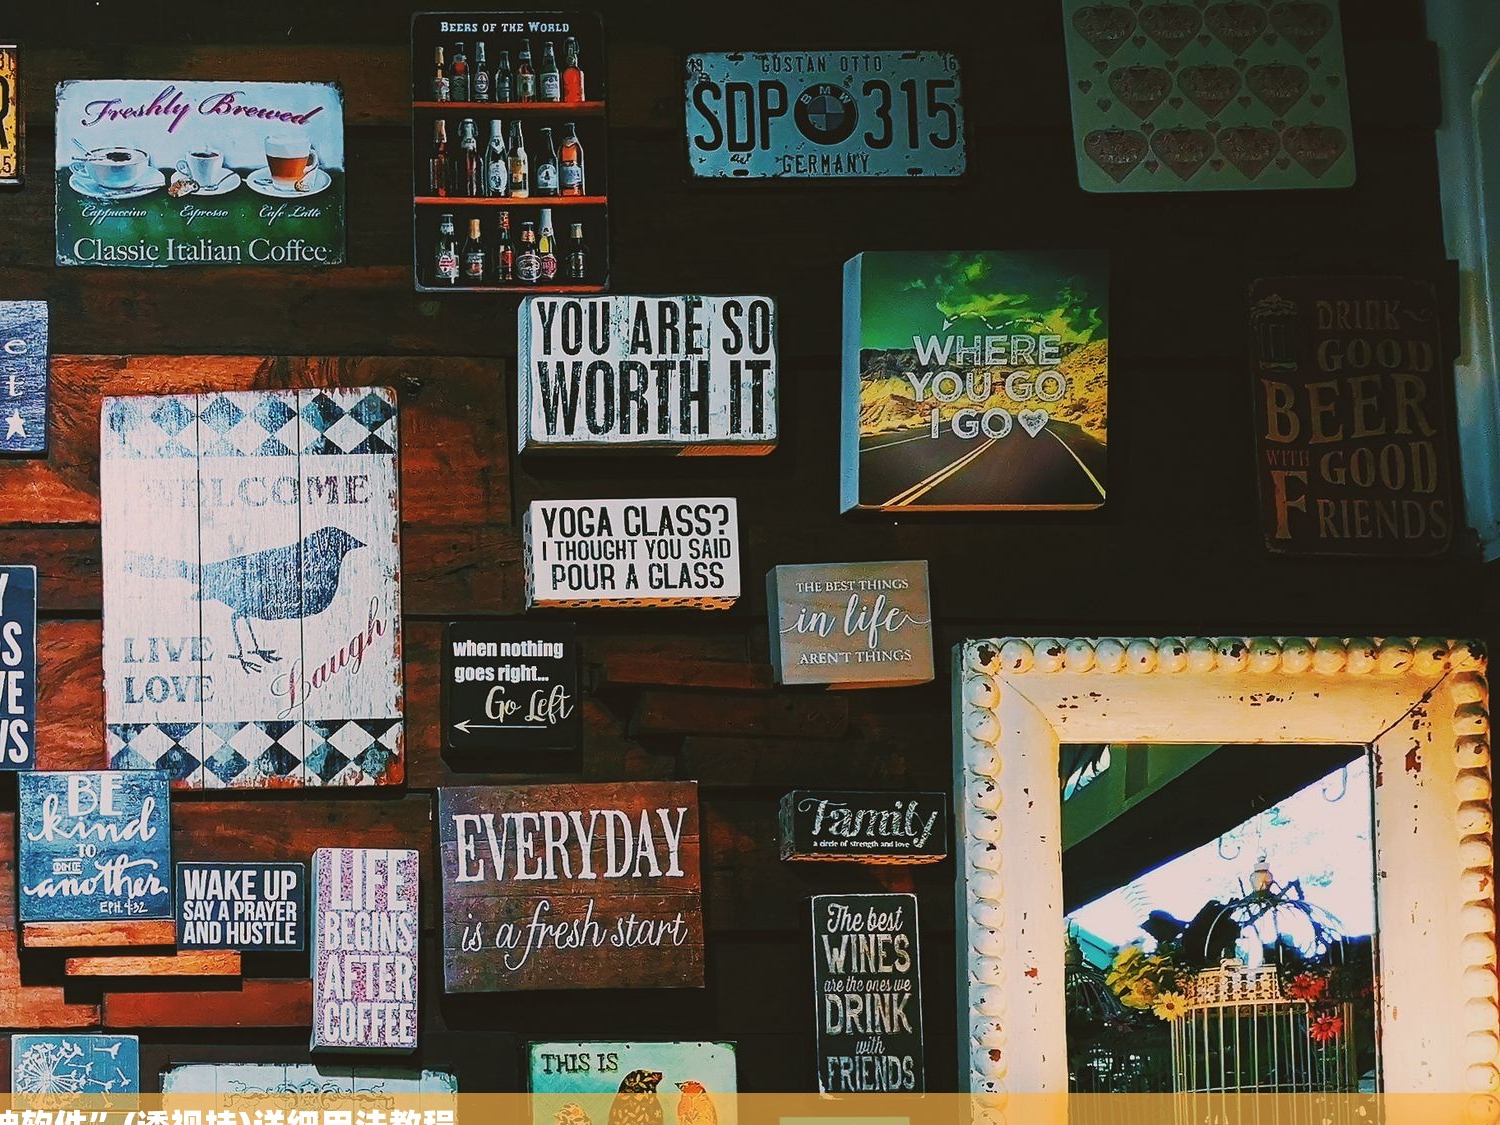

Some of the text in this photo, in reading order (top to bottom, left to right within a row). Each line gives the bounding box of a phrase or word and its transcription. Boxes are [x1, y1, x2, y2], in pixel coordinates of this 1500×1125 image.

[81, 86, 325, 133] Freshly Brewed
[692, 79, 789, 152] SDP
[865, 79, 958, 152] 315
[781, 155, 869, 175] GERMANY
[81, 205, 148, 225] Cappuccino
[180, 205, 228, 225] Espresso
[73, 236, 327, 262] Classic Italian Coffee
[538, 300, 771, 356] YOU ARE SO
[912, 334, 1061, 365] WHERE
[1317, 338, 1431, 372] GOOD
[905, 370, 1067, 402] YOU GO
[1262, 374, 1437, 444] BEER
[542, 504, 729, 538] YOGA CLASS?
[797, 579, 908, 592] THE BEST THINGS
[125, 638, 213, 664] LIVE
[453, 640, 563, 659] when nothing
[125, 675, 214, 704] LOVE
[454, 665, 548, 683] goes right...
[798, 799, 938, 849] Family
[451, 808, 688, 883] EVERYDAY
[183, 871, 296, 902] WAKE UP
[183, 923, 296, 945] AND HUSTLE
[326, 913, 413, 953] BEGINS
[462, 900, 688, 969] is a fresh start
[823, 935, 910, 974] WINES
[325, 956, 412, 1000] AFTER
[324, 1004, 413, 1045] COFFEE
[826, 996, 912, 1035] DRINK
[541, 1054, 618, 1075] THIS IS
[827, 1055, 914, 1093] FRIENDS
